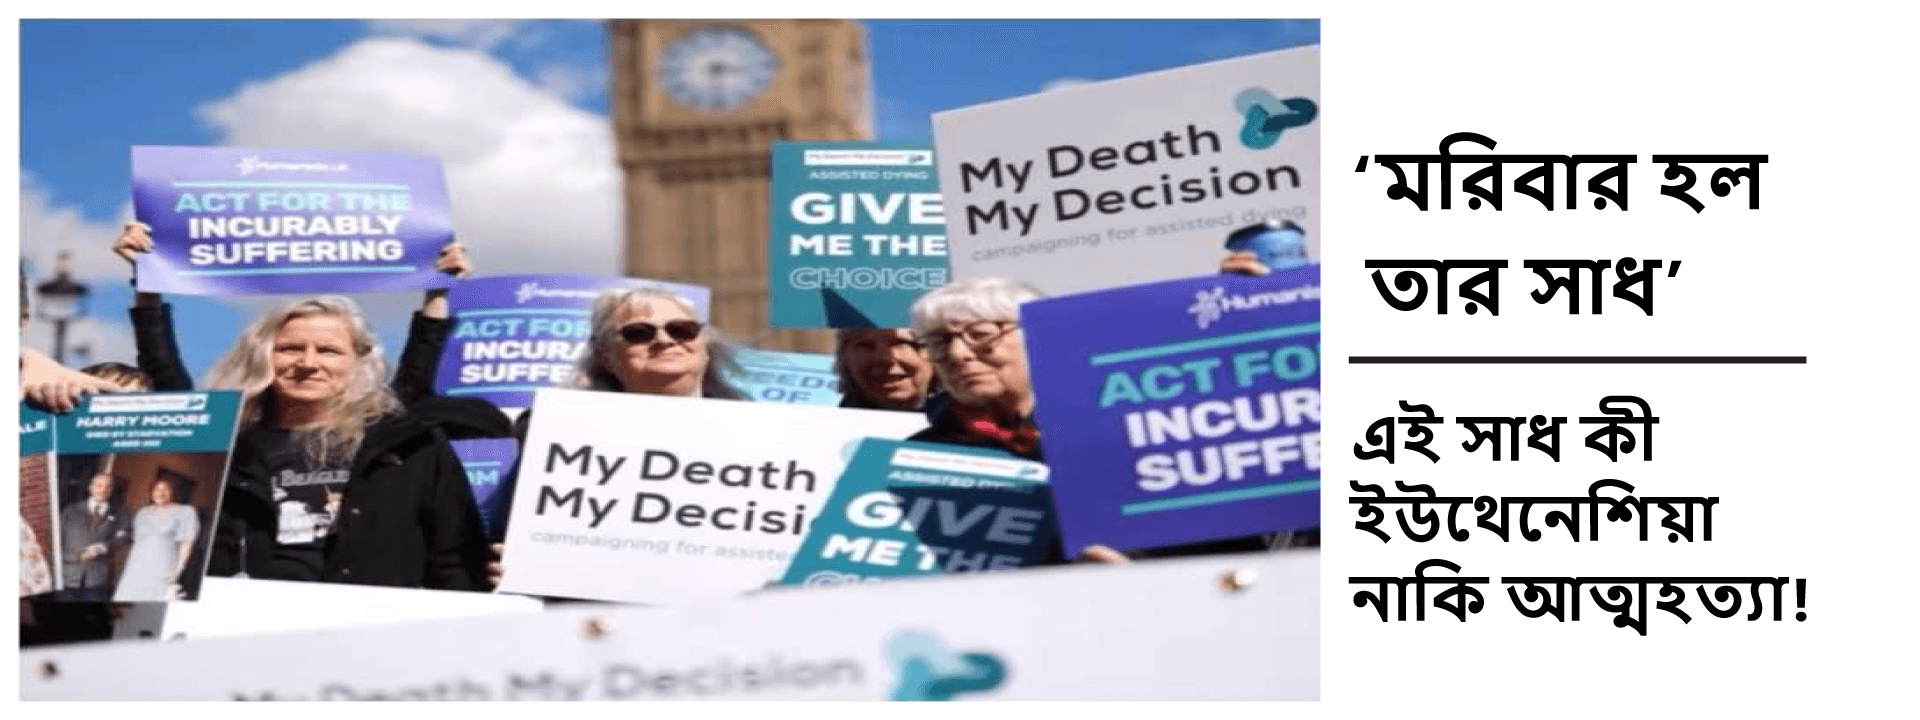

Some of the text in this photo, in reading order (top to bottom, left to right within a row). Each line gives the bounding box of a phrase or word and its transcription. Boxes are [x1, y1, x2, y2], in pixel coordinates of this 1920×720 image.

[959, 124, 1221, 194] My Death
[175, 193, 412, 213] ACT FOR THE
[790, 192, 947, 225] GIVE
[966, 163, 1301, 236] My Decision
[189, 215, 403, 239] INCURABLY
[971, 233, 1101, 262] campaigning
[1106, 226, 1137, 242] for
[1140, 214, 1234, 237] assisted
[189, 240, 405, 265] SUFFERING
[790, 233, 948, 257] ME THE
[789, 267, 948, 290] CHOICE
[453, 318, 526, 339] ACT
[460, 362, 574, 384] SUFFE
[1100, 341, 1320, 408] ACT FO
[762, 387, 813, 404] OF
[76, 412, 211, 428] HARRY MOORE
[1125, 387, 1320, 448] INCUR
[545, 442, 816, 492] My Death
[535, 485, 806, 535] My Decisi
[846, 490, 1045, 545] GIVE
[674, 539, 706, 556] for
[821, 534, 1024, 573] ME THE
[603, 652, 866, 700] Decision
